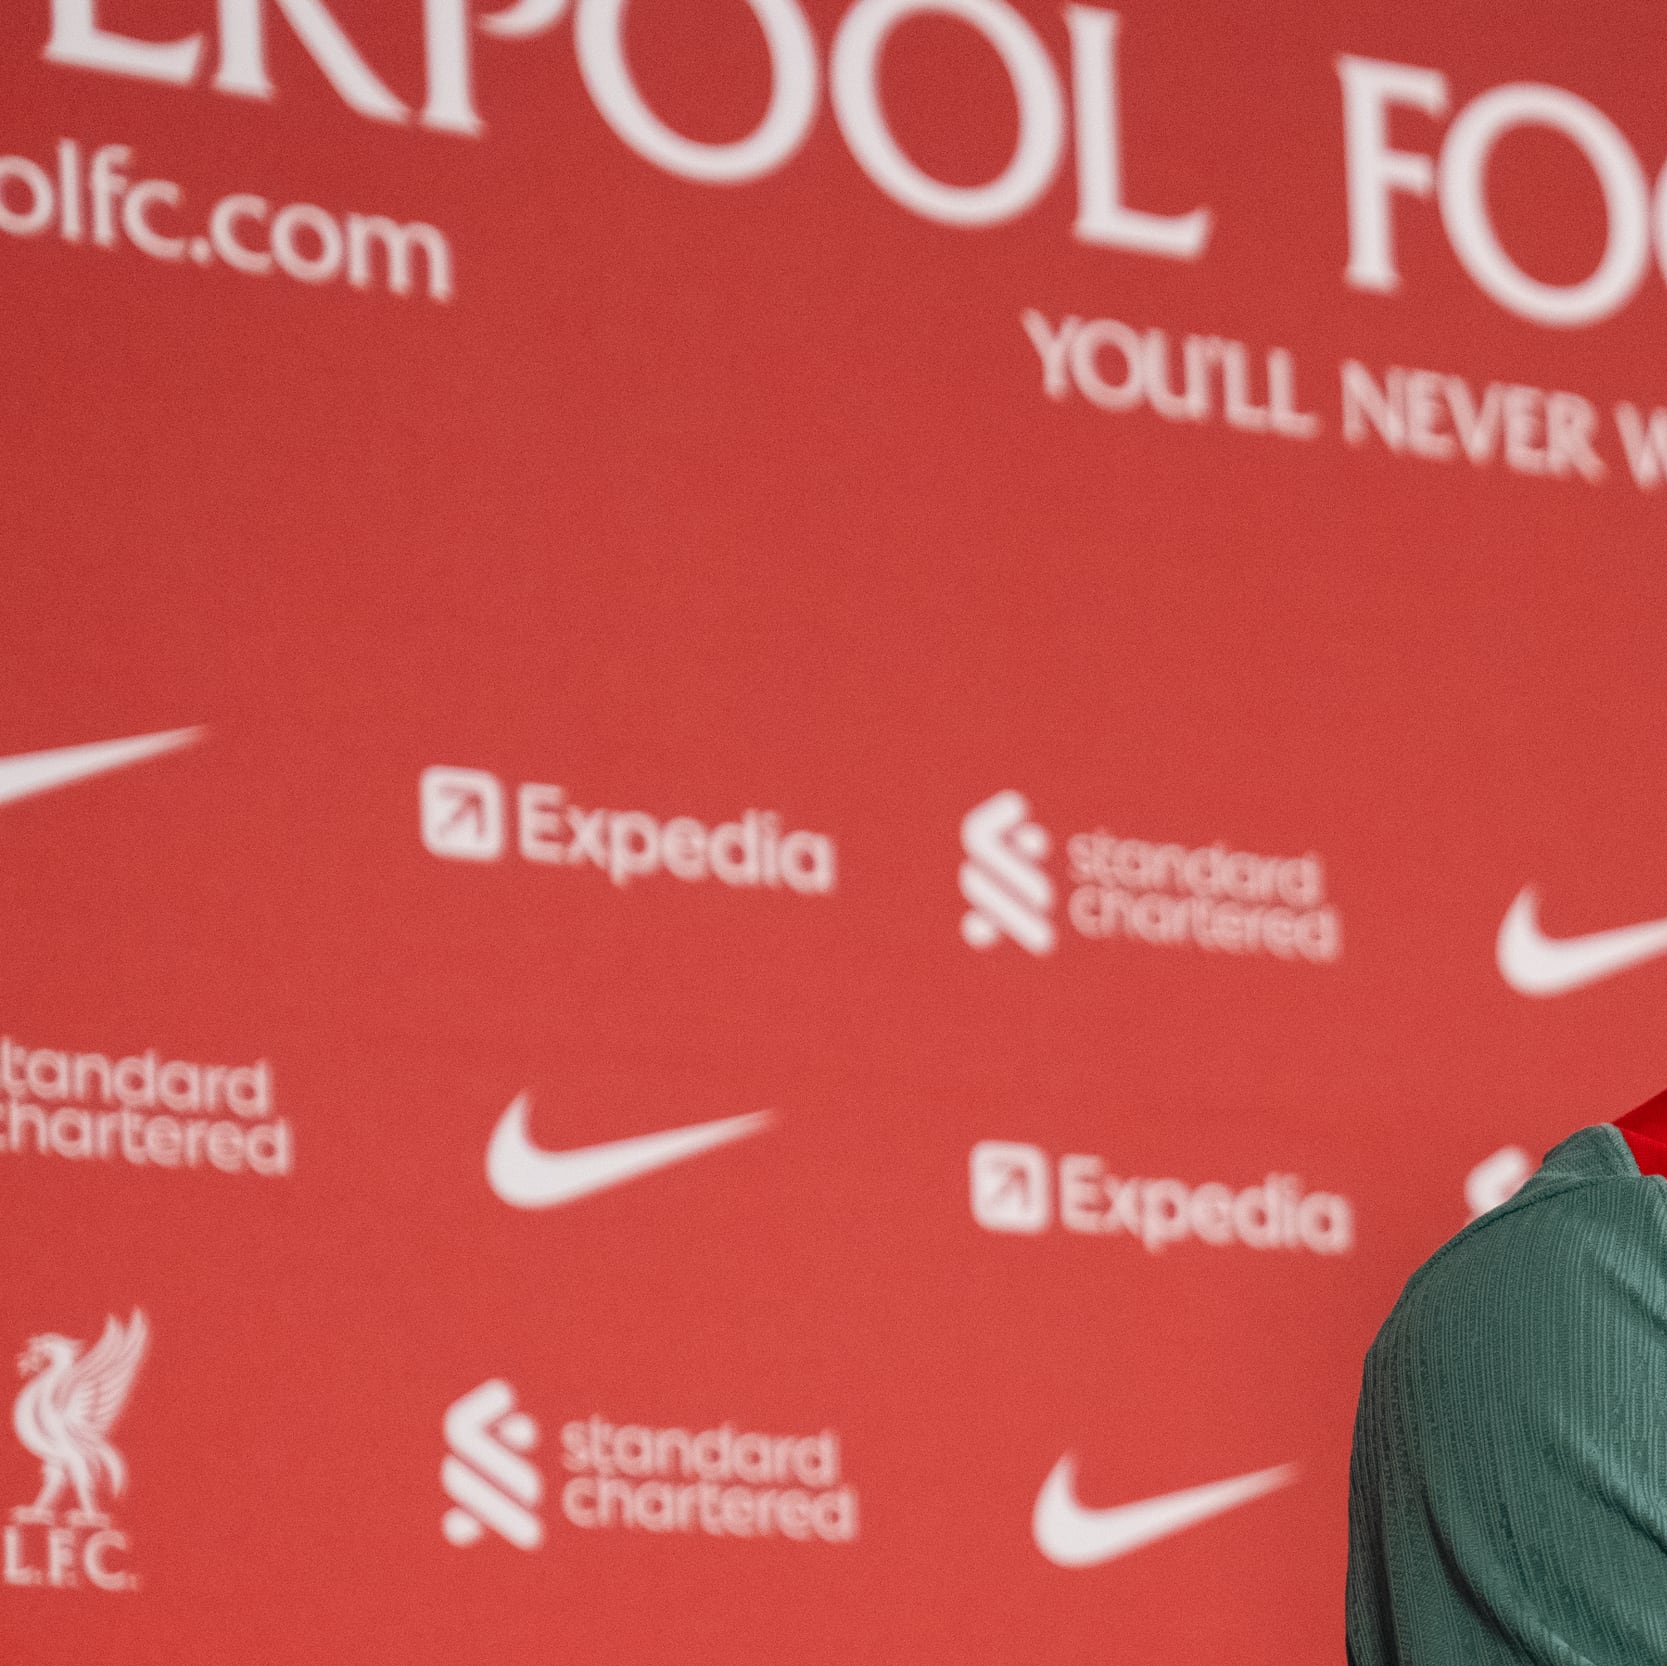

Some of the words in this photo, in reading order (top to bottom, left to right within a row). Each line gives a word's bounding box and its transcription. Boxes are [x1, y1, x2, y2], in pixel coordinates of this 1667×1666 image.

[0, 138, 453, 303] olfc.com
[1021, 309, 1319, 440] YOU'LL
[1339, 357, 1603, 480] NEVER
[516, 781, 837, 893] Expedia
[1067, 828, 1324, 905] standard
[1068, 884, 1341, 964] chartered
[0, 1100, 293, 1176] hartered
[1058, 1153, 1353, 1256] Expedia
[561, 1414, 841, 1485] standard
[561, 1474, 860, 1543] chartered
